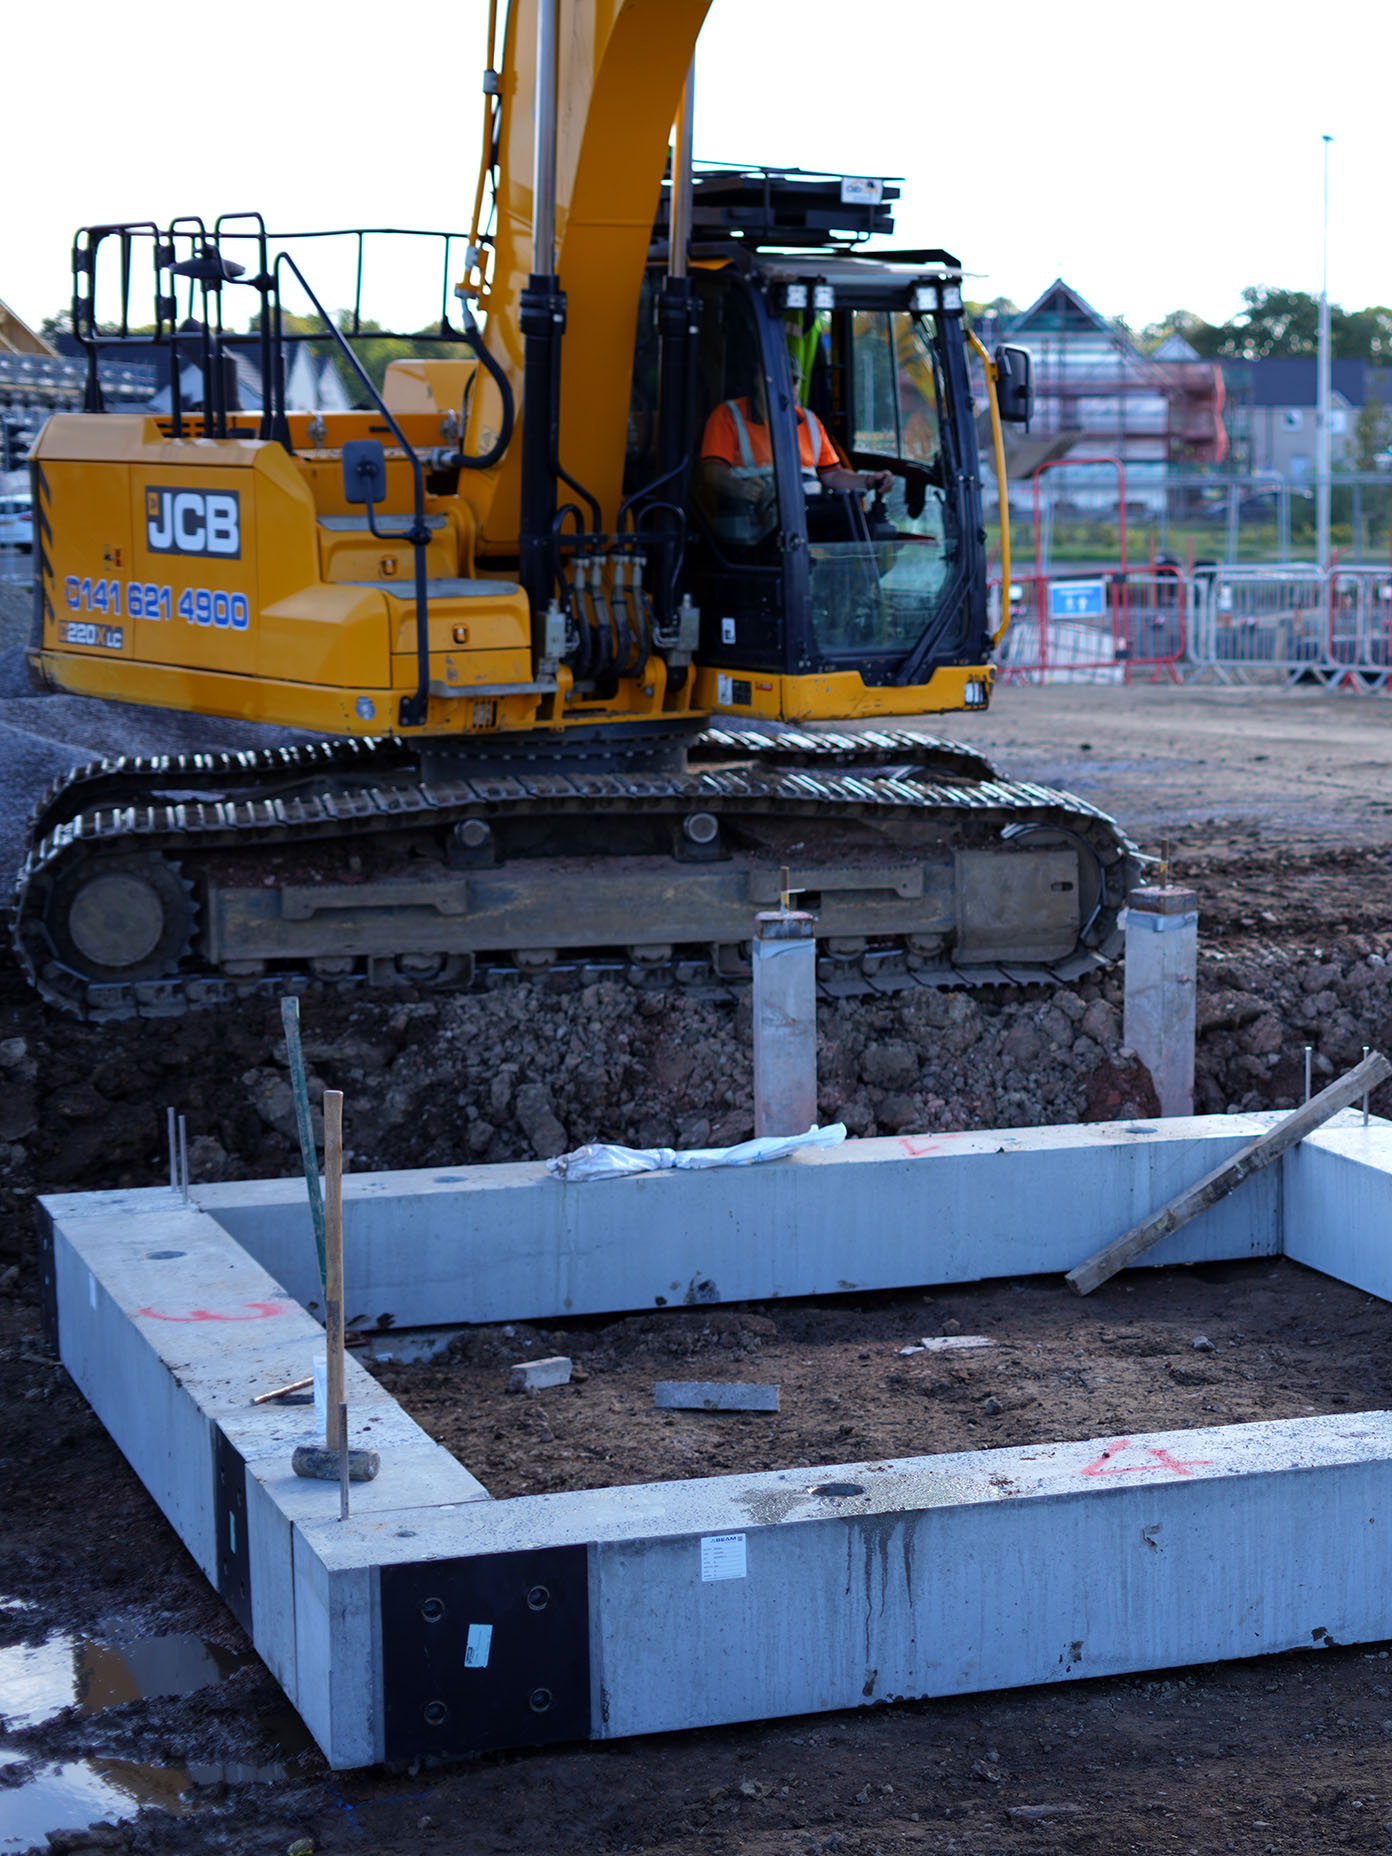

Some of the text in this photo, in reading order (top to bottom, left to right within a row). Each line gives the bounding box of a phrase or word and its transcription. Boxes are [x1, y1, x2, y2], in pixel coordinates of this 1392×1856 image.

[147, 492, 239, 554] JCB
[64, 575, 249, 632] 0141 621 4900
